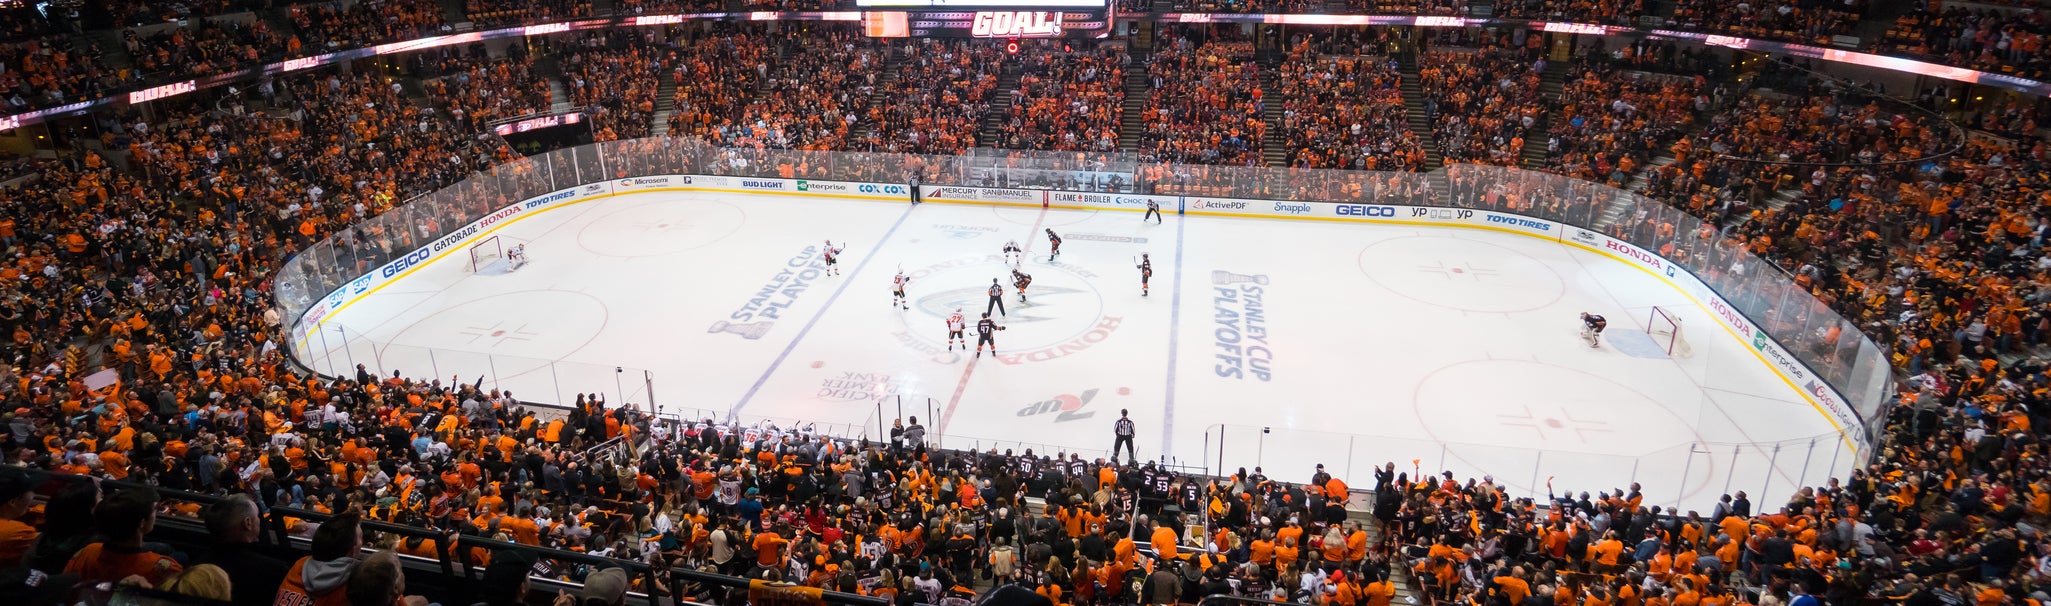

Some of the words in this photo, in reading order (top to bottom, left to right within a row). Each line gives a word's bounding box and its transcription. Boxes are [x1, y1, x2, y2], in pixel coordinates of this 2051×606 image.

[971, 11, 1063, 38] GOAL!
[129, 79, 197, 105] GOAL!
[634, 176, 669, 185] Microsemi
[742, 180, 759, 188] BUD
[760, 181, 783, 189] LIGHT
[799, 182, 846, 191] enterprise
[859, 184, 881, 193] COX
[884, 185, 906, 194] COX
[942, 187, 978, 195] MERCURY
[982, 188, 997, 196] SAN
[1002, 189, 1032, 197] MANUEL
[526, 196, 549, 209] TOYO
[549, 190, 576, 202] TIRES
[1055, 193, 1076, 202] FLAME
[1084, 195, 1111, 203] BROILER
[1205, 201, 1246, 209] ActivePDF
[1274, 202, 1311, 214] Snapple
[1335, 204, 1396, 217] GEICO
[1412, 207, 1428, 217] yp
[1457, 209, 1473, 219] yp
[480, 205, 522, 229] HONDA
[1486, 214, 1517, 225] TOYO
[1518, 218, 1551, 231] TIRES
[434, 224, 478, 252] GATORADE
[787, 244, 818, 269] CUP
[1605, 239, 1662, 269] HONDA
[382, 247, 430, 278] GEICO
[353, 276, 372, 293] SAP
[330, 290, 346, 308] SAP
[730, 267, 795, 322] STANLEY
[951, 315, 962, 324] 27
[1239, 283, 1269, 345] STANLEY
[1709, 297, 1751, 338] HONDA
[980, 325, 990, 334] 47
[1213, 286, 1244, 380] PLAYOFFS
[994, 315, 1122, 367] HONDA
[1246, 345, 1273, 382] CUP
[1756, 337, 1804, 380] enterprise
[841, 371, 891, 385] BANK
[821, 378, 900, 395] PREMIER
[816, 388, 889, 402] PACIFIC
[1016, 388, 1100, 423] 7UP
[1814, 384, 1838, 413] Coors
[1836, 407, 1855, 432] LIGHT
[1020, 462, 1032, 473] 50
[1072, 466, 1084, 476] 44
[1144, 475, 1151, 485] 2
[1156, 481, 1168, 492] 53
[1189, 490, 1196, 501] 5
[1123, 499, 1132, 511] 15
